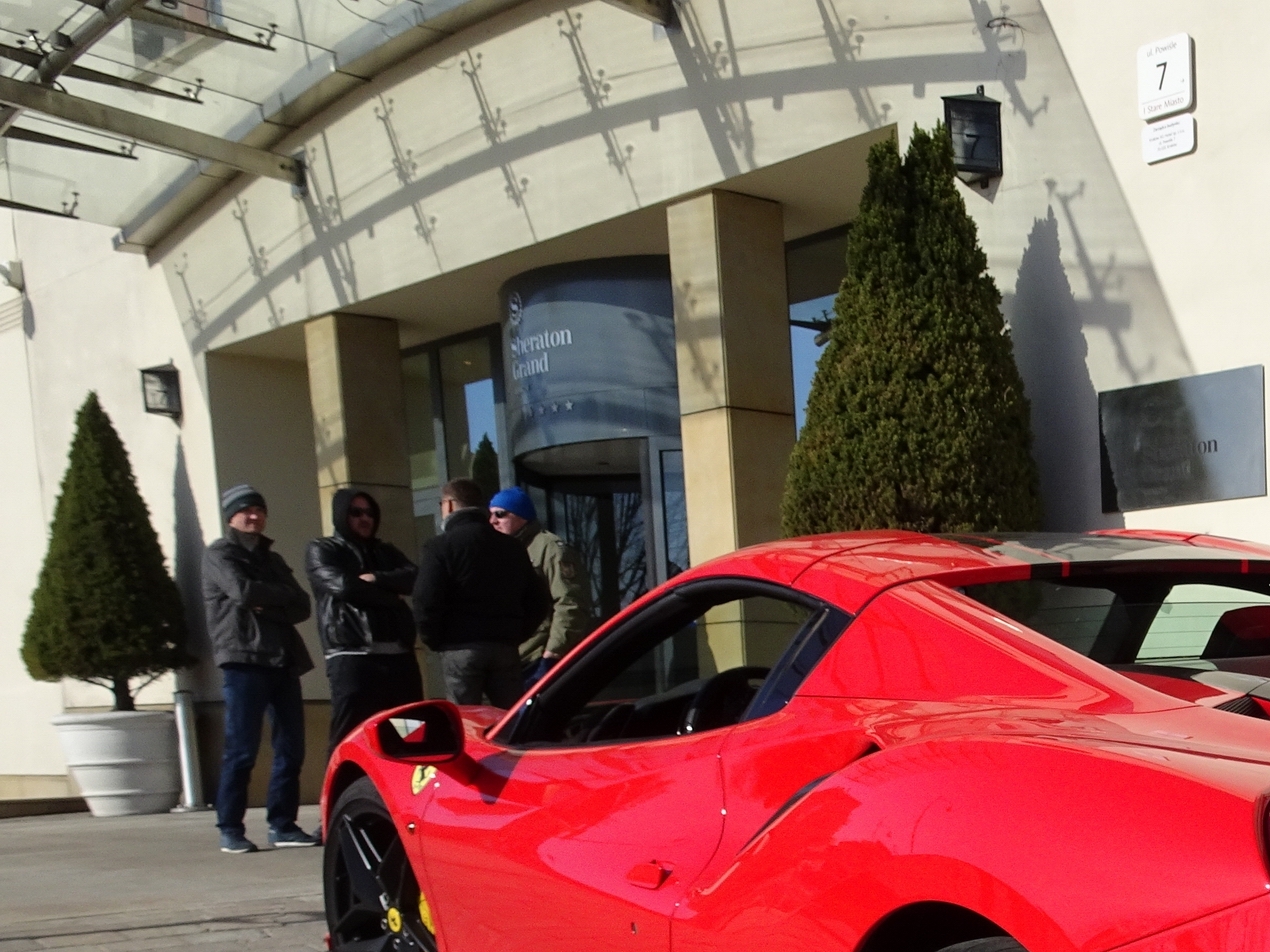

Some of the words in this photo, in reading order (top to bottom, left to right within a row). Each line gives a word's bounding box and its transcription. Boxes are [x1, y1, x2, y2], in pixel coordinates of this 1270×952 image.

[1156, 61, 1168, 91] 7
[511, 328, 573, 358] Sheraton
[512, 352, 549, 380] Grand
